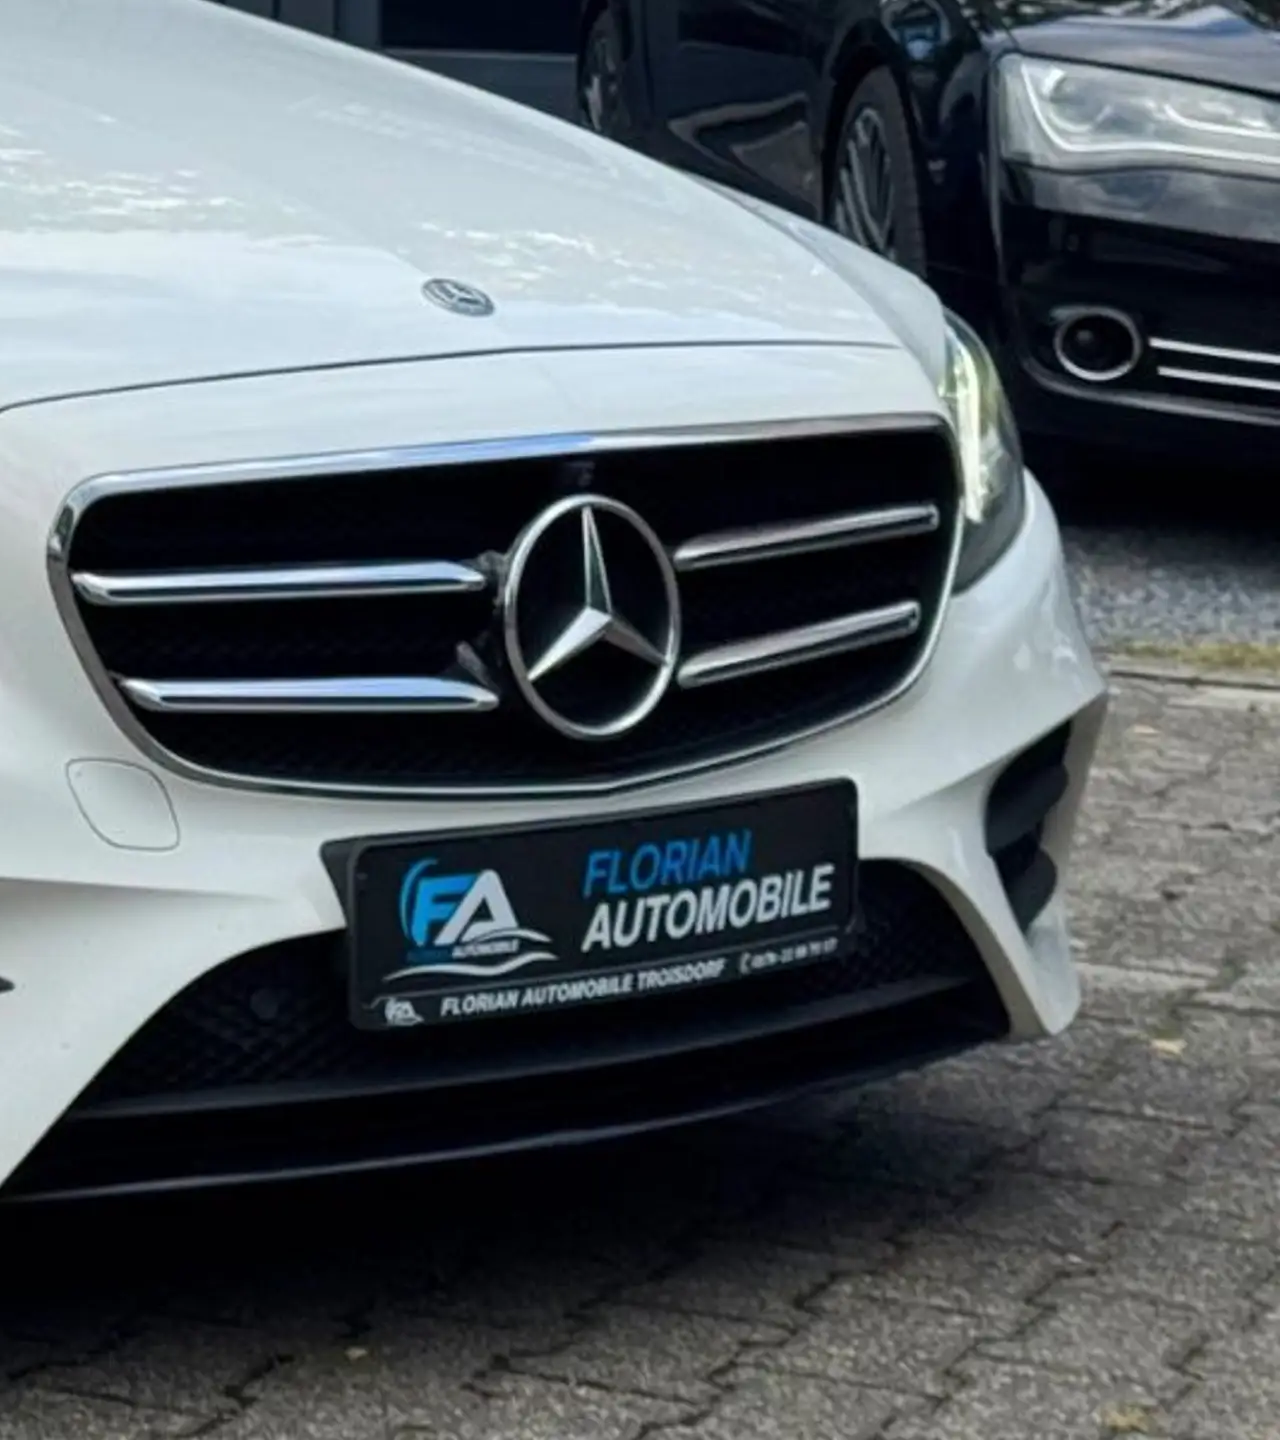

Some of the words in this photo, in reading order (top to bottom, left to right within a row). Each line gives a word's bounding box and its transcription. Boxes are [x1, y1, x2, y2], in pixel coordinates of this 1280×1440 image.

[583, 829, 752, 898] FLORIAN
[411, 869, 519, 948] FA
[581, 863, 835, 953] AUTOMOBILE
[441, 989, 519, 1016] FLORIAN
[521, 973, 634, 1007] AUTOMOBILE
